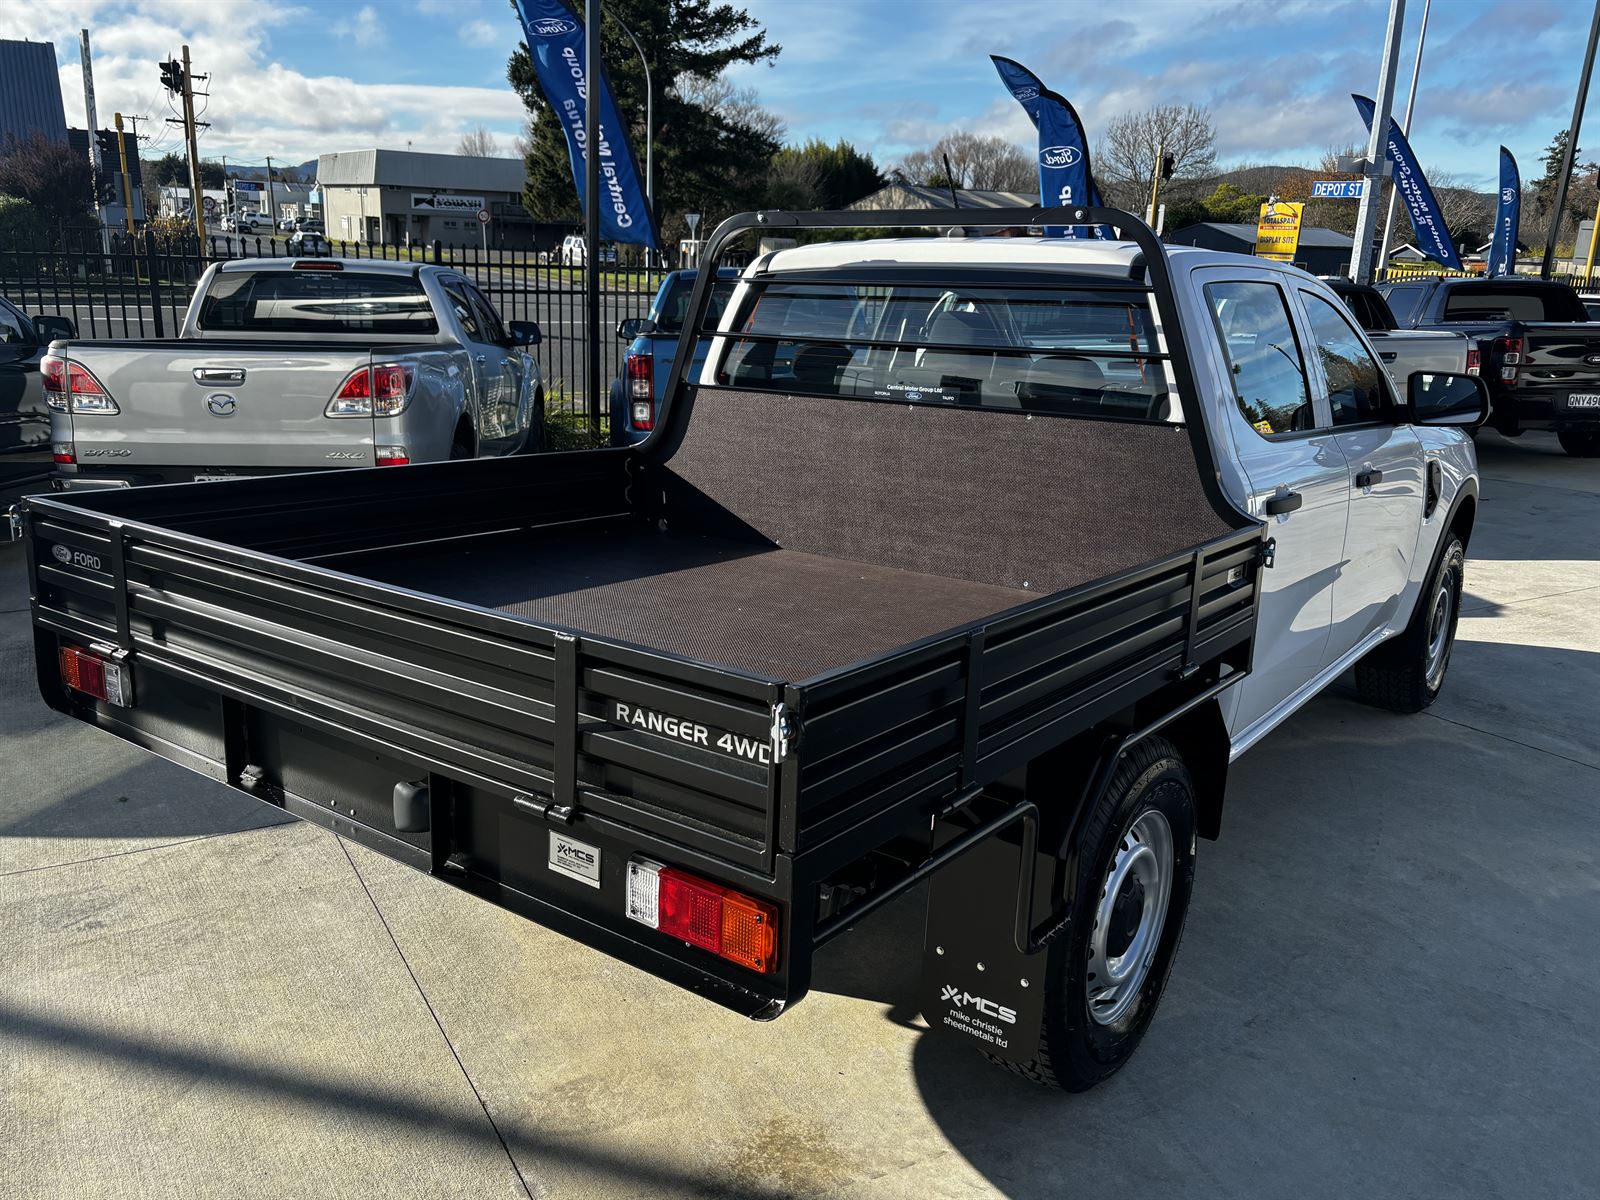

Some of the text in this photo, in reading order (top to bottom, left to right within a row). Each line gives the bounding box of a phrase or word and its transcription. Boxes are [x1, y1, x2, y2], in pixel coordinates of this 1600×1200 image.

[1314, 183, 1362, 196] DEPOT ST
[1260, 236, 1295, 244] DISPLAY SITE
[74, 551, 101, 569] FORD
[616, 703, 770, 764] RANGER 4WD
[568, 846, 594, 864] MCS
[963, 991, 1017, 1024] MCS
[943, 1016, 1008, 1048] sheetmetals ltd
[949, 1009, 1003, 1036] mike christie
